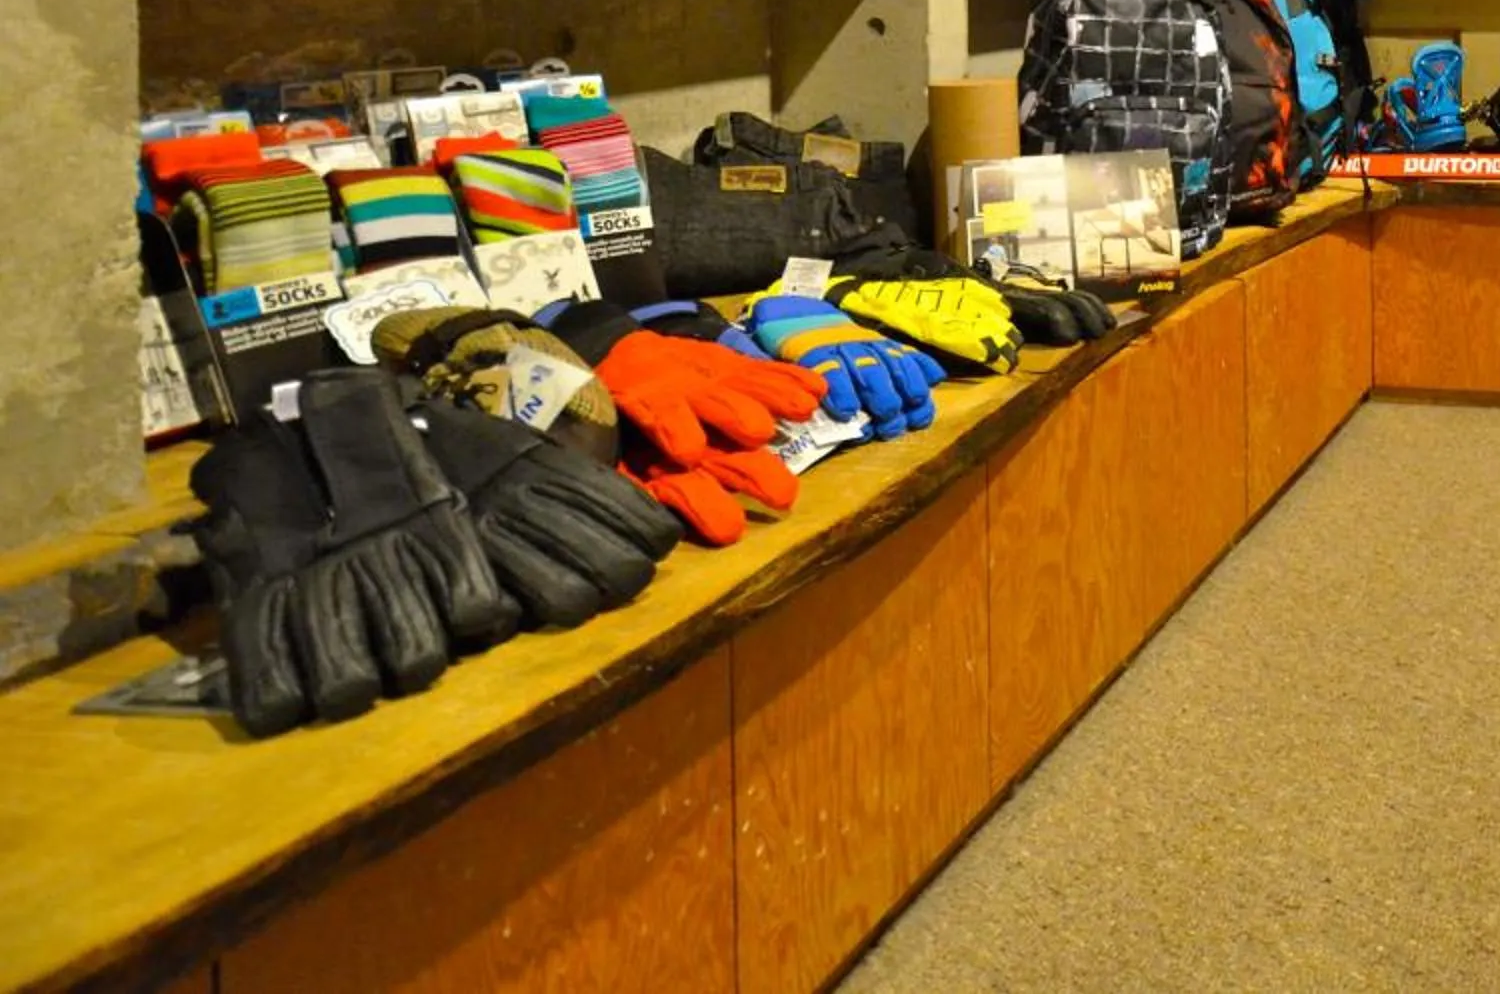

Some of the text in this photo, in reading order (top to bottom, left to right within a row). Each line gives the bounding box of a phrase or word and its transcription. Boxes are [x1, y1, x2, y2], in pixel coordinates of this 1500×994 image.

[1403, 157, 1492, 174] BURTON
[593, 215, 641, 233] SOCKS
[264, 283, 327, 309] SOCKS
